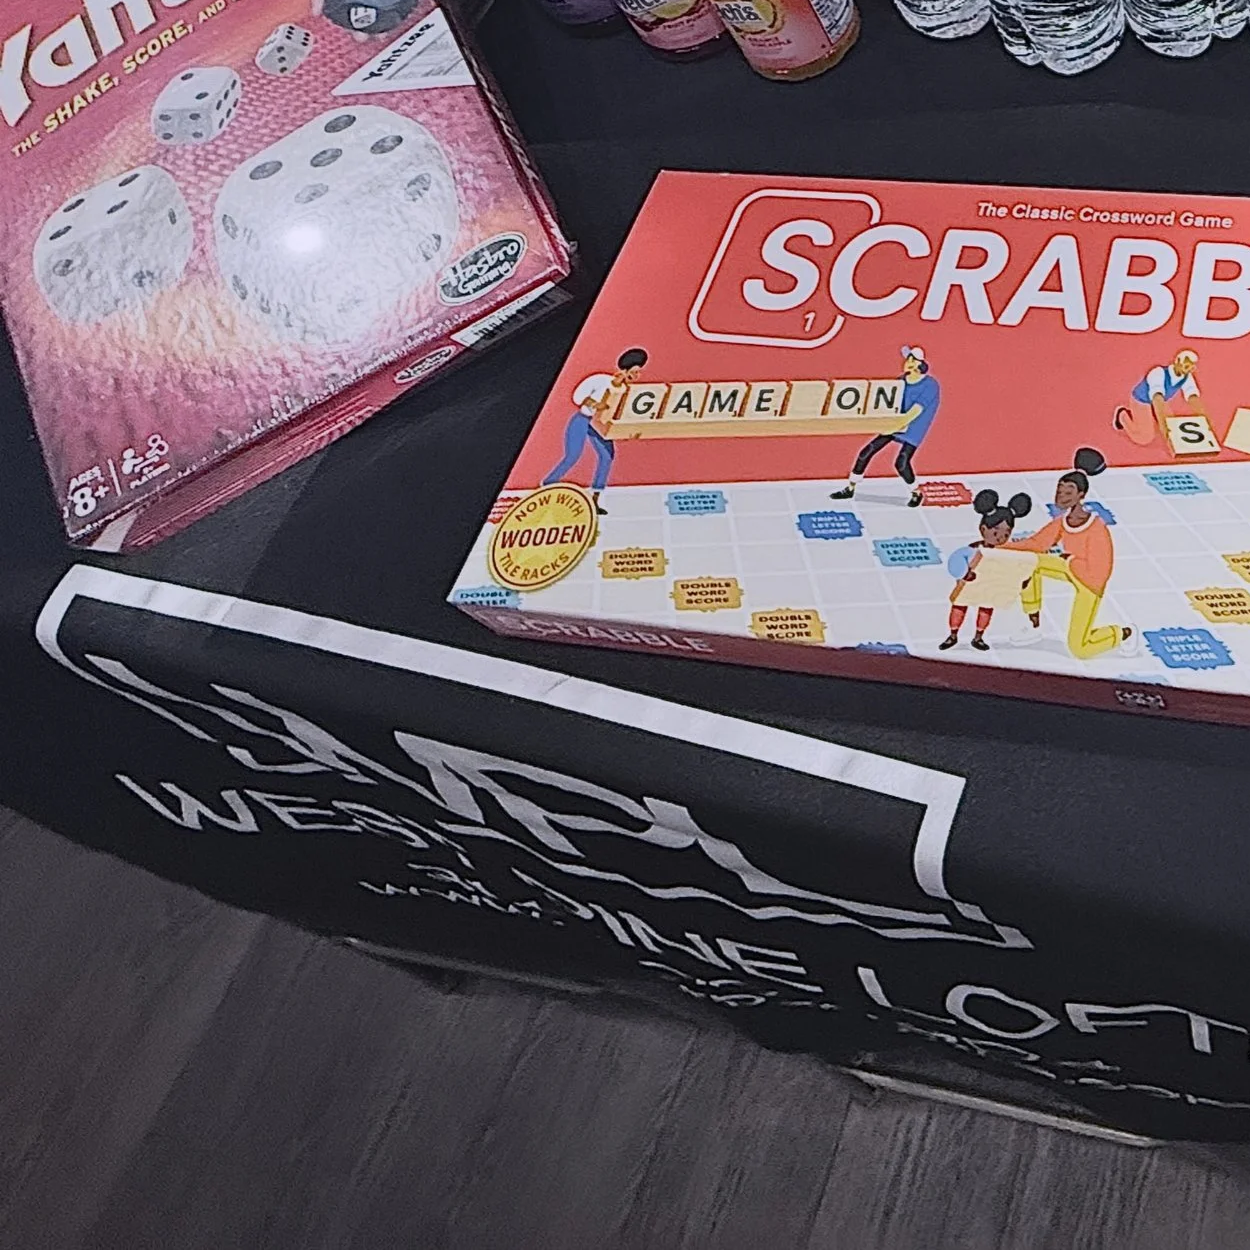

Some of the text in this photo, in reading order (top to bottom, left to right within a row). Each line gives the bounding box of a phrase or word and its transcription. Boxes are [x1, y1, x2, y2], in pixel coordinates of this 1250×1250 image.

[716, 2, 761, 22] ch's
[362, 20, 436, 83] Yahtzee
[12, 130, 42, 158] THE
[44, 73, 120, 134] SHAKE,
[122, 19, 195, 76] SCORE,
[977, 202, 1234, 229] The Classic Crossword Game
[439, 238, 521, 288] Hasbro
[456, 260, 515, 295] Gaming
[803, 311, 817, 334] 1
[631, 385, 898, 416] GAME ON
[1178, 421, 1206, 444] S
[73, 484, 110, 518] 8+
[515, 494, 552, 523] NOW
[556, 493, 585, 518] WITH
[500, 524, 586, 550] WOODEN
[499, 552, 570, 581] TILE RACKS
[608, 552, 659, 560] DOUBLE
[680, 582, 732, 590] DOUBLE
[1194, 592, 1246, 601] DOUBLE
[685, 597, 730, 605] SCORE
[1206, 600, 1247, 608] WORD
[758, 613, 813, 623] DOUBLE
[765, 622, 809, 631] WORD
[495, 613, 715, 653] SCRABBLE
[766, 630, 813, 640] SCORE
[1159, 634, 1203, 643] TRIPLE
[1163, 642, 1212, 652] LETTER
[1172, 652, 1218, 662] SCORE
